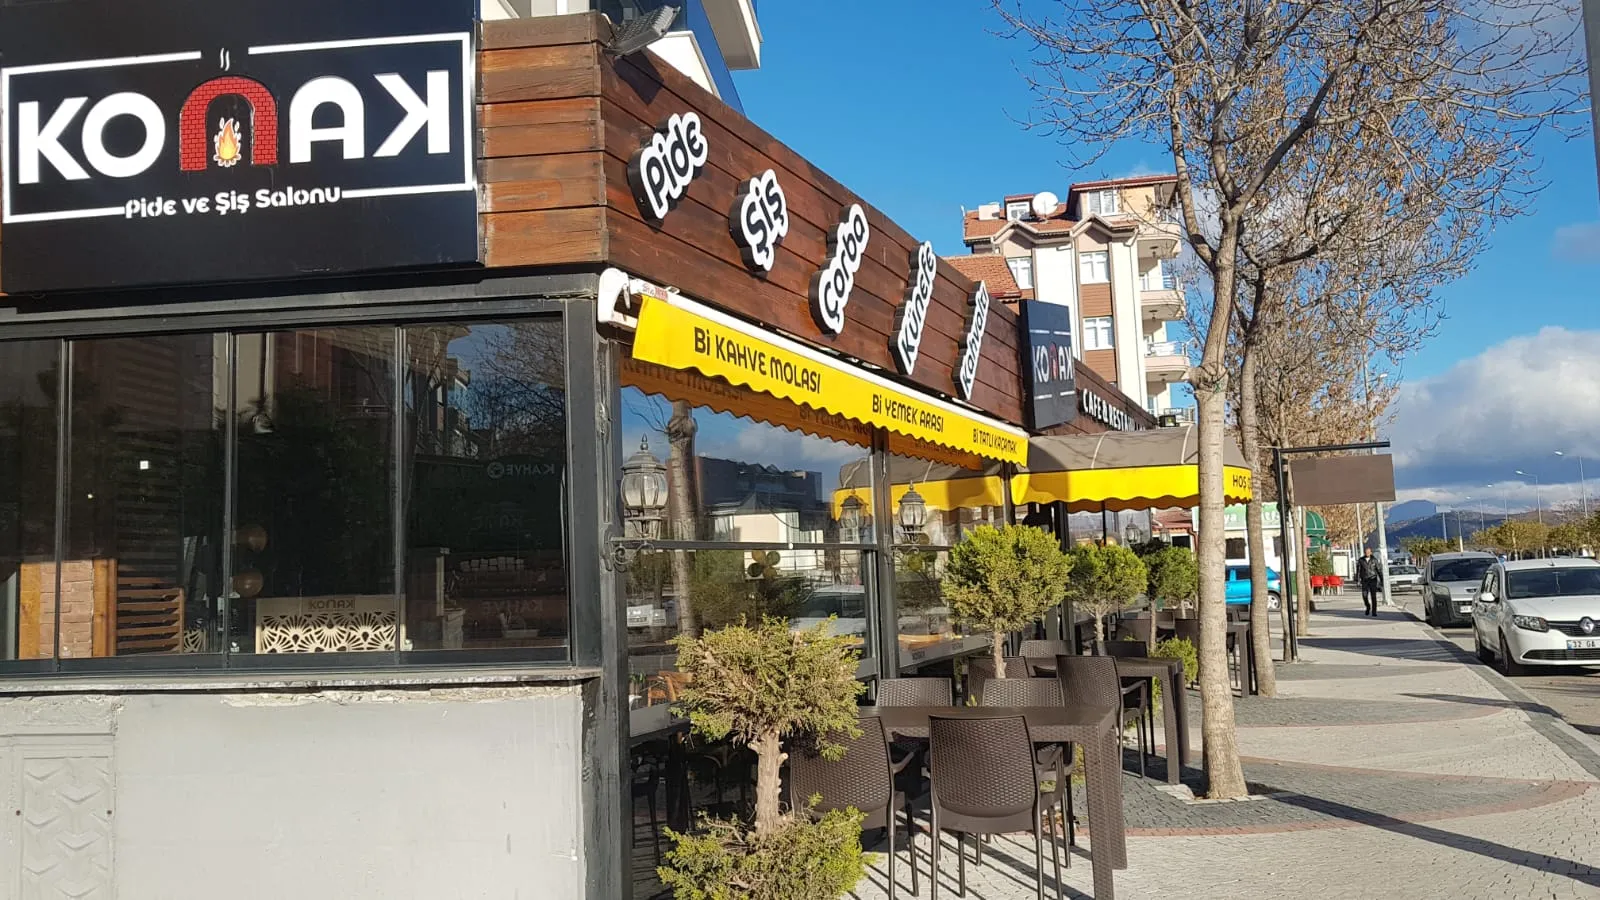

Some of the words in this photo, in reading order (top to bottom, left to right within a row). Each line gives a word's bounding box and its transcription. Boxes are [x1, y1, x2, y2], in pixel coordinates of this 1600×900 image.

[125, 197, 177, 219] Pide
[182, 197, 209, 214] ve
[215, 190, 250, 216] Şiş
[256, 185, 342, 209] Salonu
[645, 119, 705, 212] Pide
[745, 176, 785, 262] Şiş
[823, 212, 867, 323] Çorba
[903, 248, 935, 366] Künefe
[715, 334, 767, 376] KAHVE
[770, 356, 821, 395] MOLASI
[885, 397, 918, 425] YEMEK
[920, 409, 944, 433] ARASI
